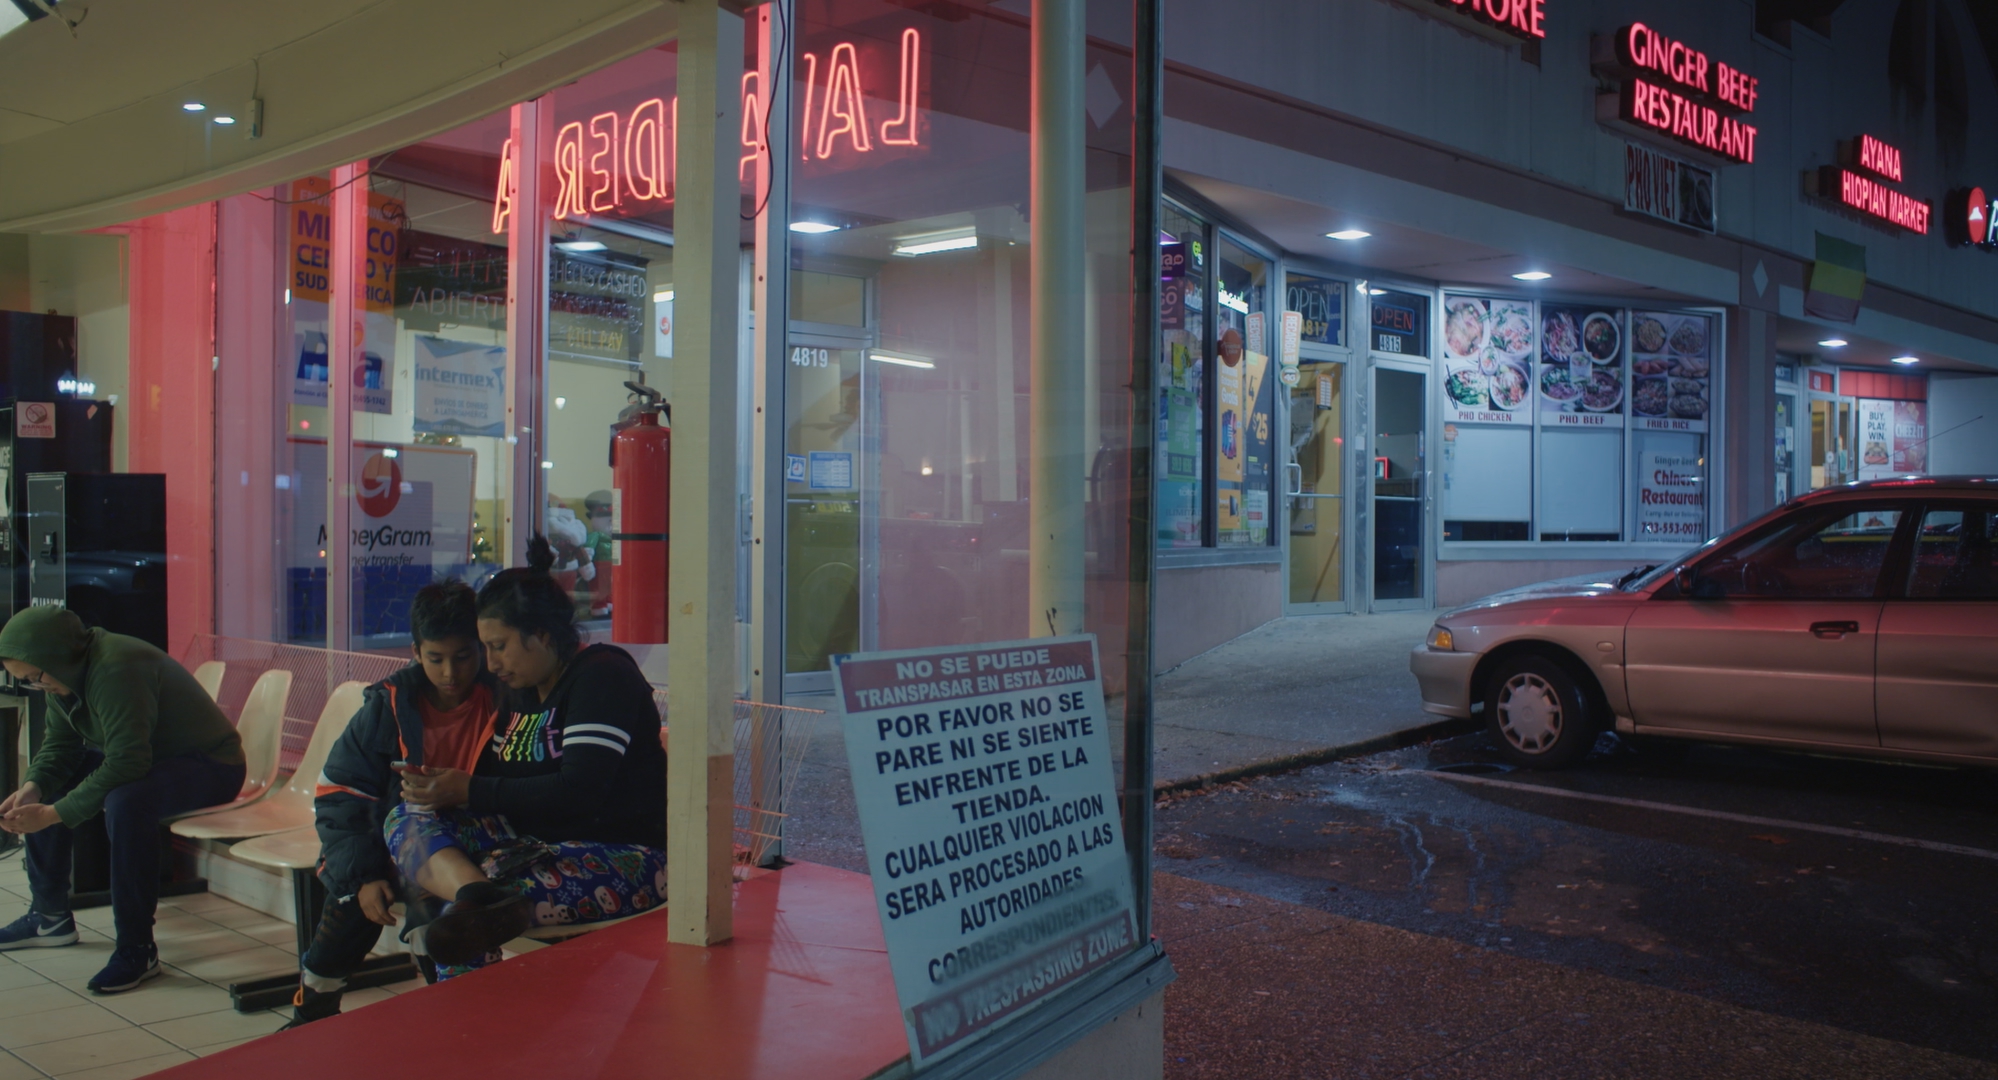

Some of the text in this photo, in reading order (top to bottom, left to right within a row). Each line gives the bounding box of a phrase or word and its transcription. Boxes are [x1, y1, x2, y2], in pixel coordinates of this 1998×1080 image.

[1452, 0, 1545, 38] ORE
[1629, 22, 1758, 112] GINGER BEEF
[1634, 78, 1757, 163] RESTAURANT
[1861, 134, 1902, 182] AYANA
[1627, 144, 1675, 220] PHO VIET
[1842, 170, 1929, 235] HIOPIAN MARKET
[297, 210, 396, 256] MCO
[296, 271, 392, 304] SUDERICA
[383, 262, 395, 283] Y
[598, 271, 648, 298] CASHED
[1287, 287, 1330, 324] OPEN
[1373, 306, 1412, 331] OPEN
[568, 326, 623, 352] BILL PAY
[1380, 335, 1400, 351] 4815
[791, 347, 828, 368] 4819
[415, 363, 495, 389] intermex
[466, 400, 489, 410] DINERO
[1458, 411, 1512, 422] PHO CHICKEN
[1559, 415, 1605, 425] PHO BEEF
[1647, 419, 1690, 430] FRIED RICE
[1654, 456, 1680, 467] Ginger
[1642, 488, 1703, 506] Restaurant
[317, 524, 431, 551] MneyGram
[352, 553, 414, 567] ney transfer
[896, 649, 1050, 680] NO SE PUEDE
[856, 664, 1087, 708] TRANSPASAR EN ESTA ZONA
[877, 691, 1085, 741] POR FAVOR NO SE
[875, 716, 1094, 774] PARE NI SE SIENTE
[894, 746, 1089, 806] ENFRENTE DE LA
[952, 784, 1050, 824] TIENDA.
[884, 794, 1104, 879] CUALQUIER VIOLACION
[886, 823, 1114, 919] SERA PROCESADO A LAS
[959, 866, 1084, 935] AUTORIDADES
[922, 920, 1130, 1046] NO TRESPASSING ZONE
